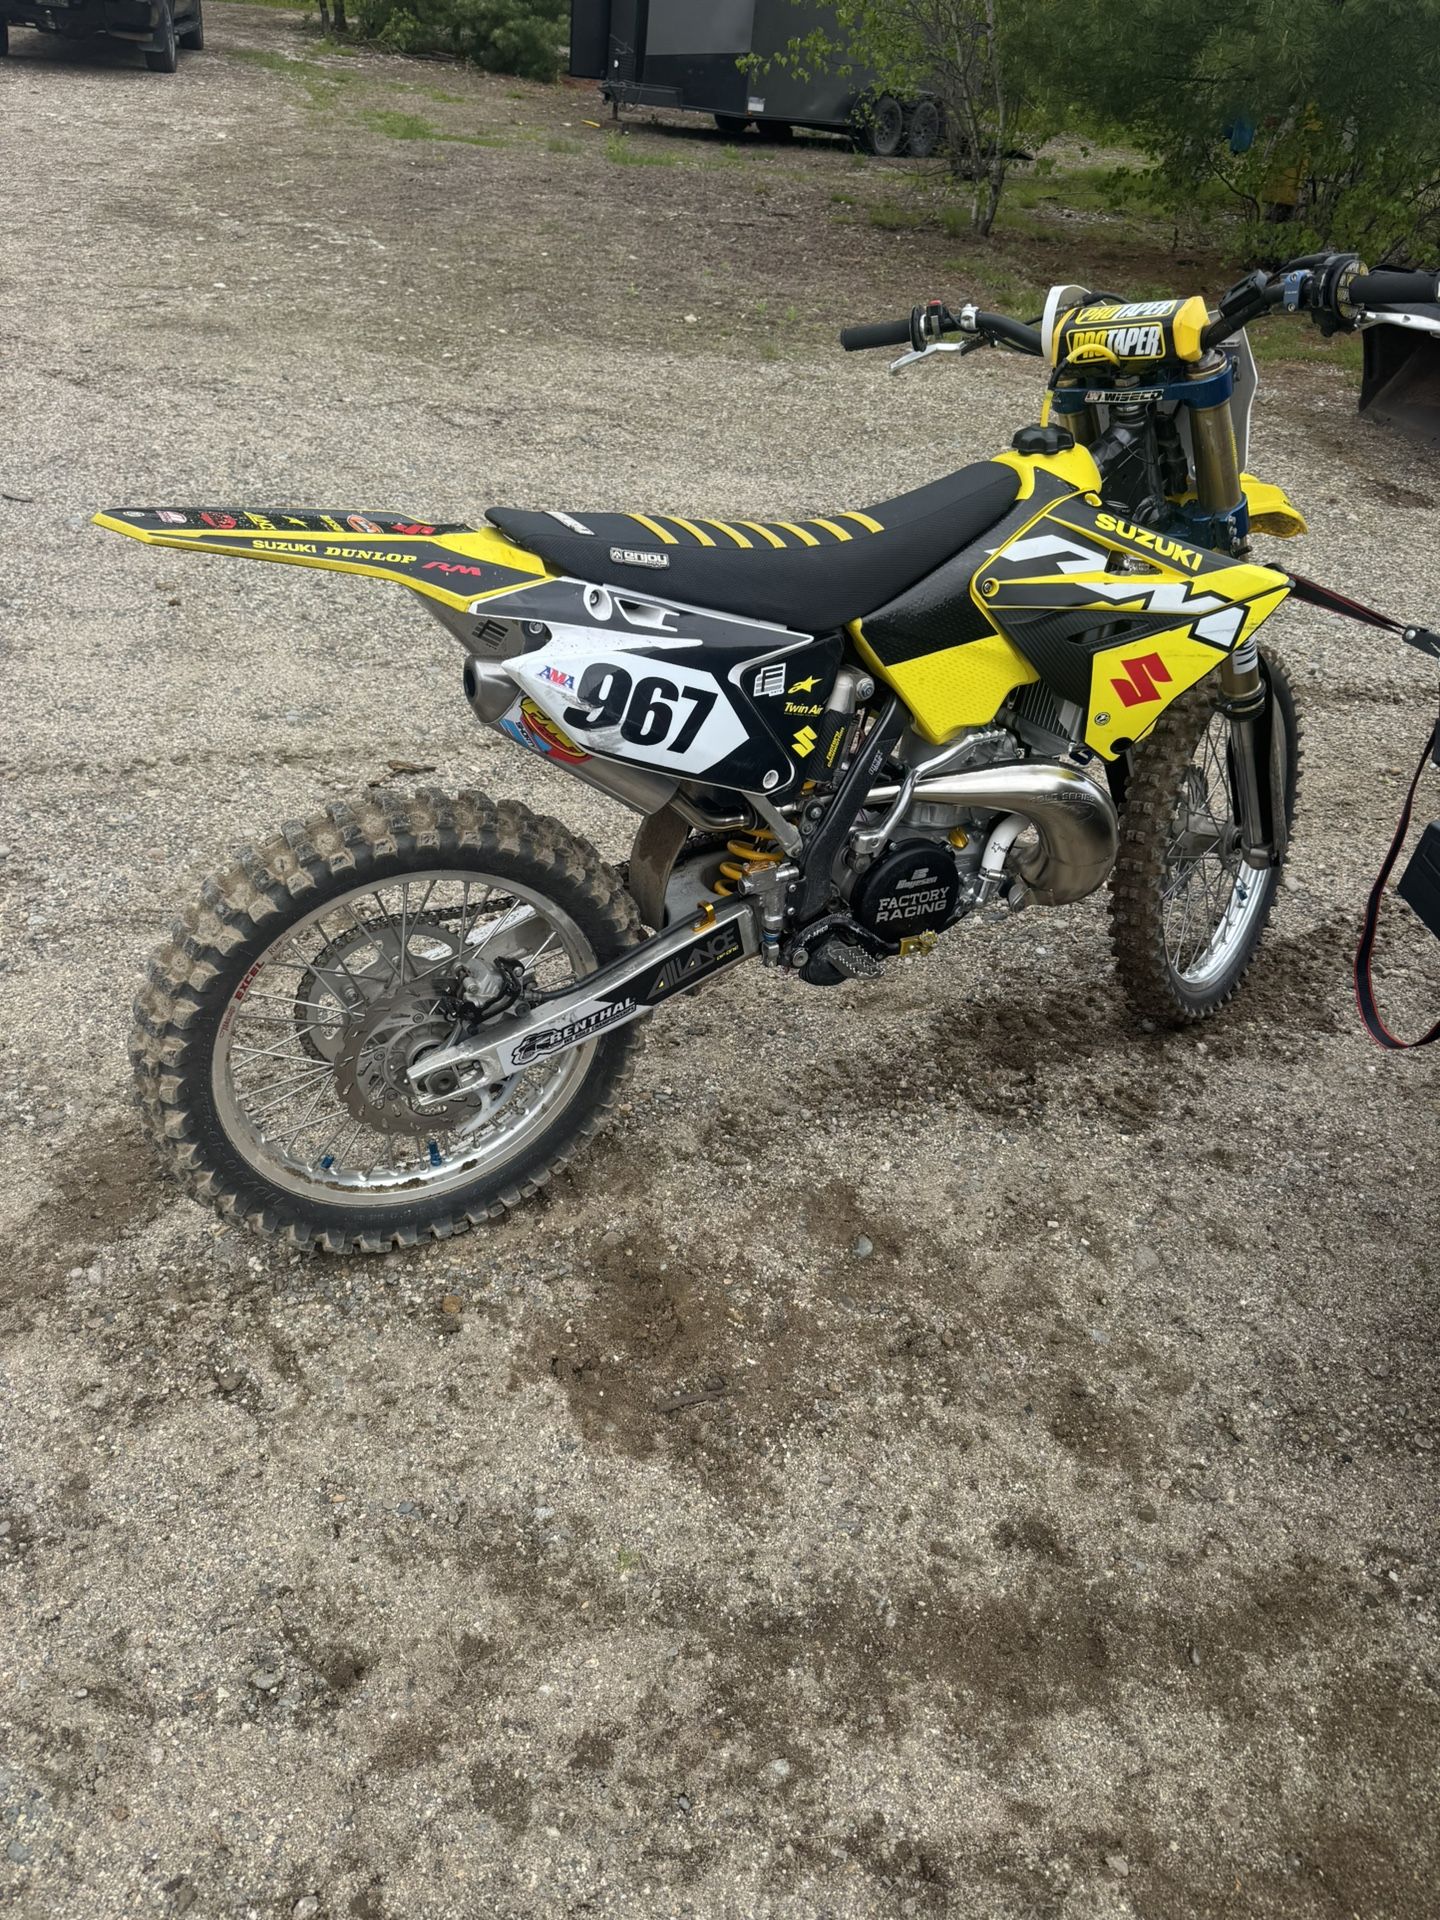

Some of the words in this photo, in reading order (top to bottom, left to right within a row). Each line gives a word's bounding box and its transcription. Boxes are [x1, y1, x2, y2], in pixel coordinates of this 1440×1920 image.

[1083, 301, 1173, 321] PROTAPER
[1105, 390, 1163, 401] WISECO
[252, 540, 317, 553] SUZUKI
[324, 546, 417, 564] DUNLOP
[1095, 513, 1203, 571] SUZUKI
[537, 665, 576, 690] AMA
[563, 662, 718, 754] 967
[784, 702, 808, 715] Twin
[808, 704, 824, 716] Air
[878, 886, 950, 911] FACTORY
[875, 899, 948, 924] RACING
[234, 961, 265, 1001] EXCEL
[549, 996, 637, 1045] RENTHAL
